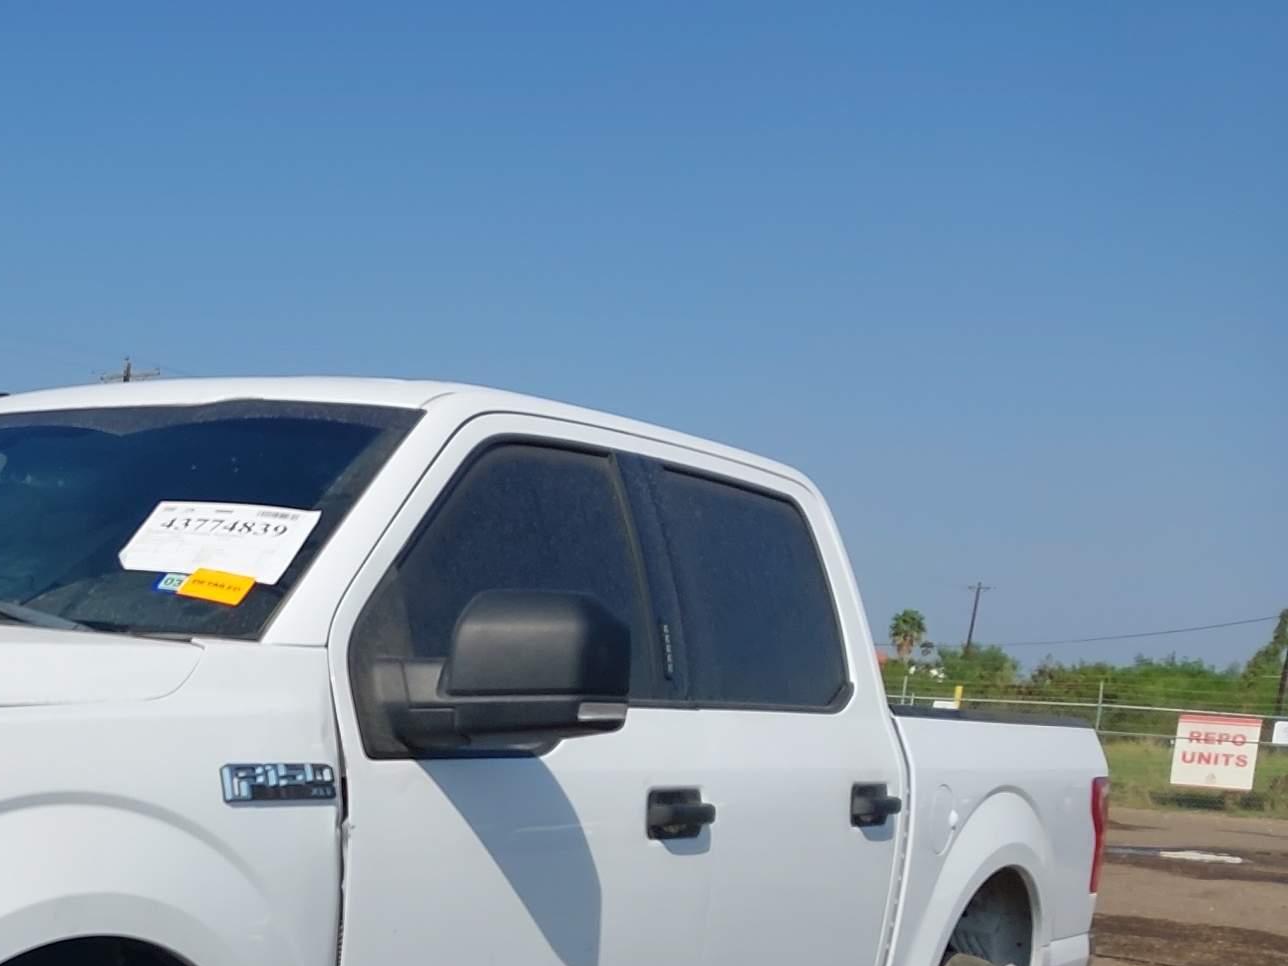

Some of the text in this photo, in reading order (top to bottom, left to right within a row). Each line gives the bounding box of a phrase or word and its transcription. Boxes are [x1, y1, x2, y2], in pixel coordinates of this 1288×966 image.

[160, 518, 288, 537] 43774839
[1188, 730, 1248, 747] REPO
[1181, 751, 1249, 768] UNITS
